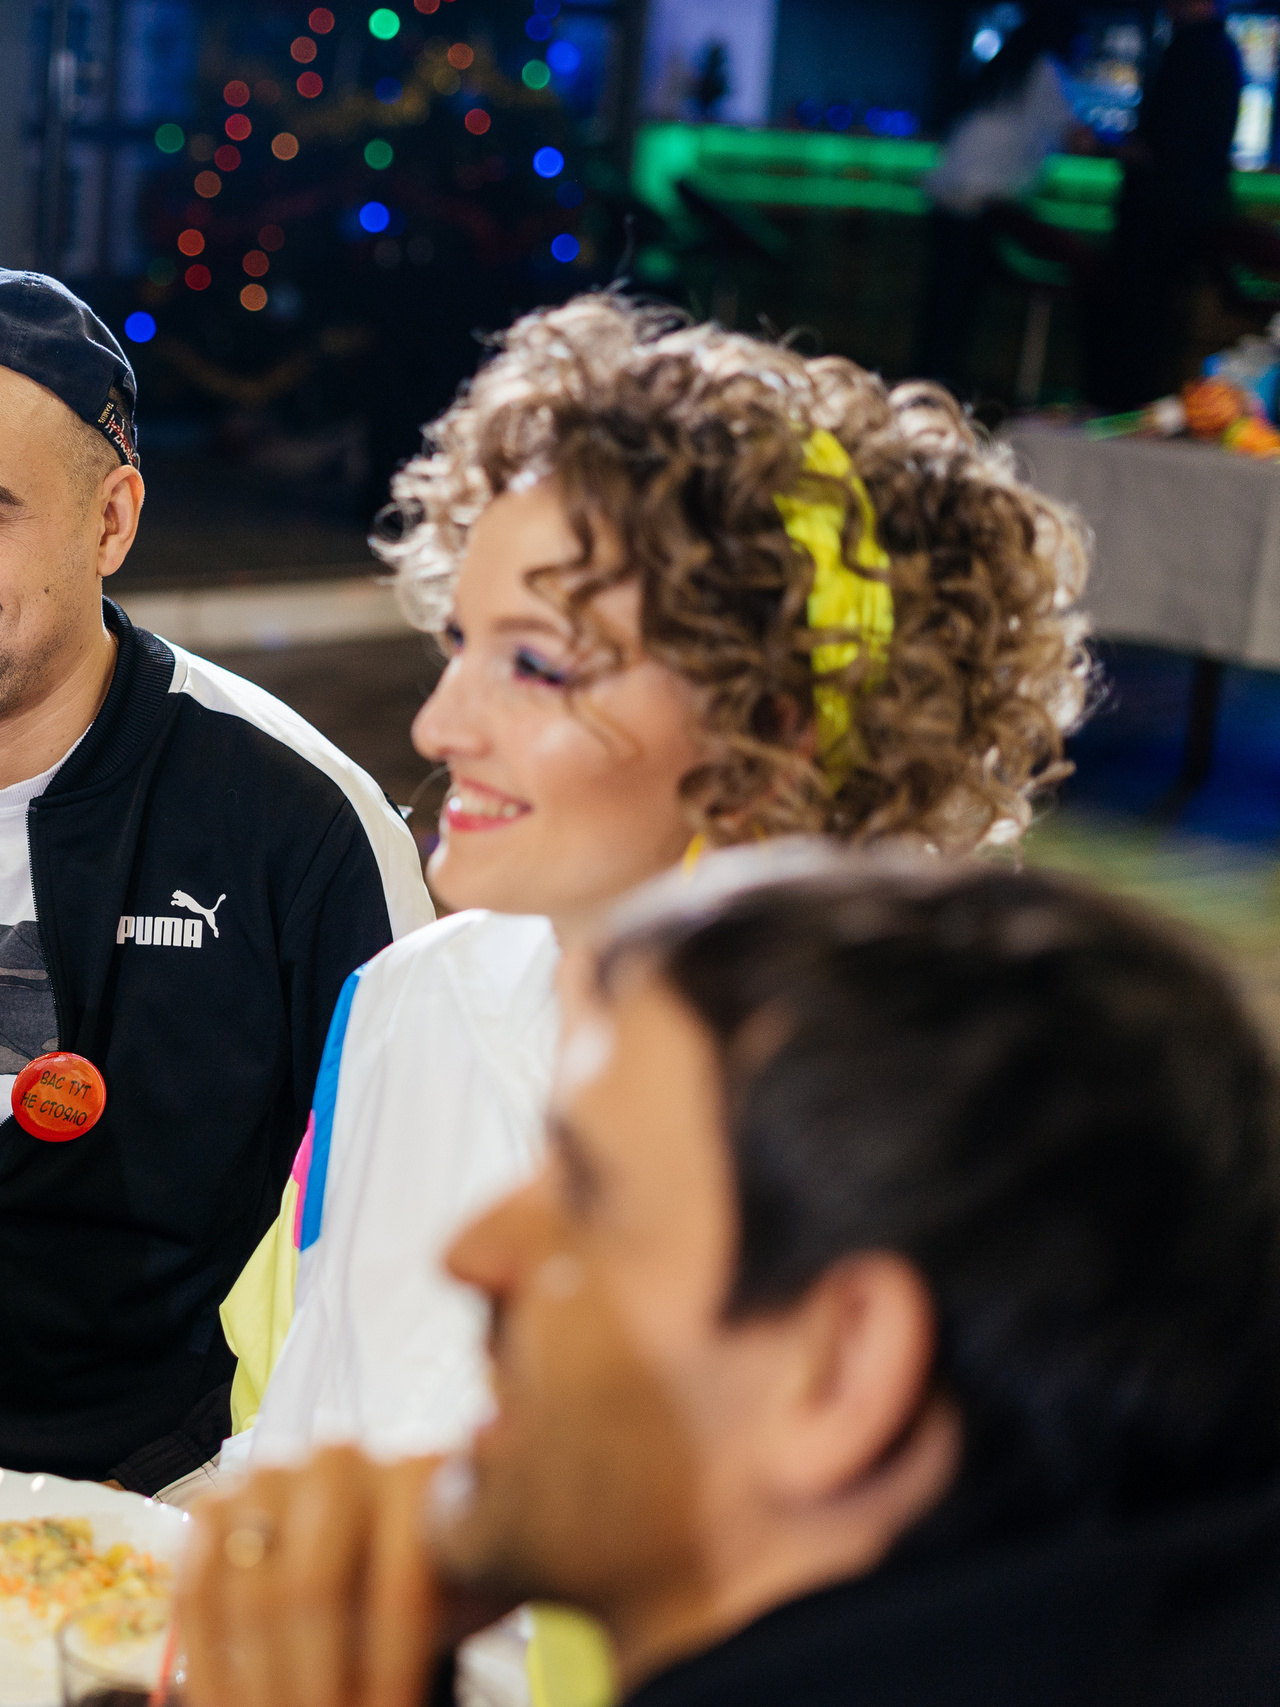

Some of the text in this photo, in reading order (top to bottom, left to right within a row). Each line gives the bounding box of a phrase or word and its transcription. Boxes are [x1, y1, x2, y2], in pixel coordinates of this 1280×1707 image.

[116, 915, 203, 949] PUMA
[39, 1070, 91, 1099] ВАС ТУТ
[20, 1092, 88, 1126] НЕ СТОЯЛО
